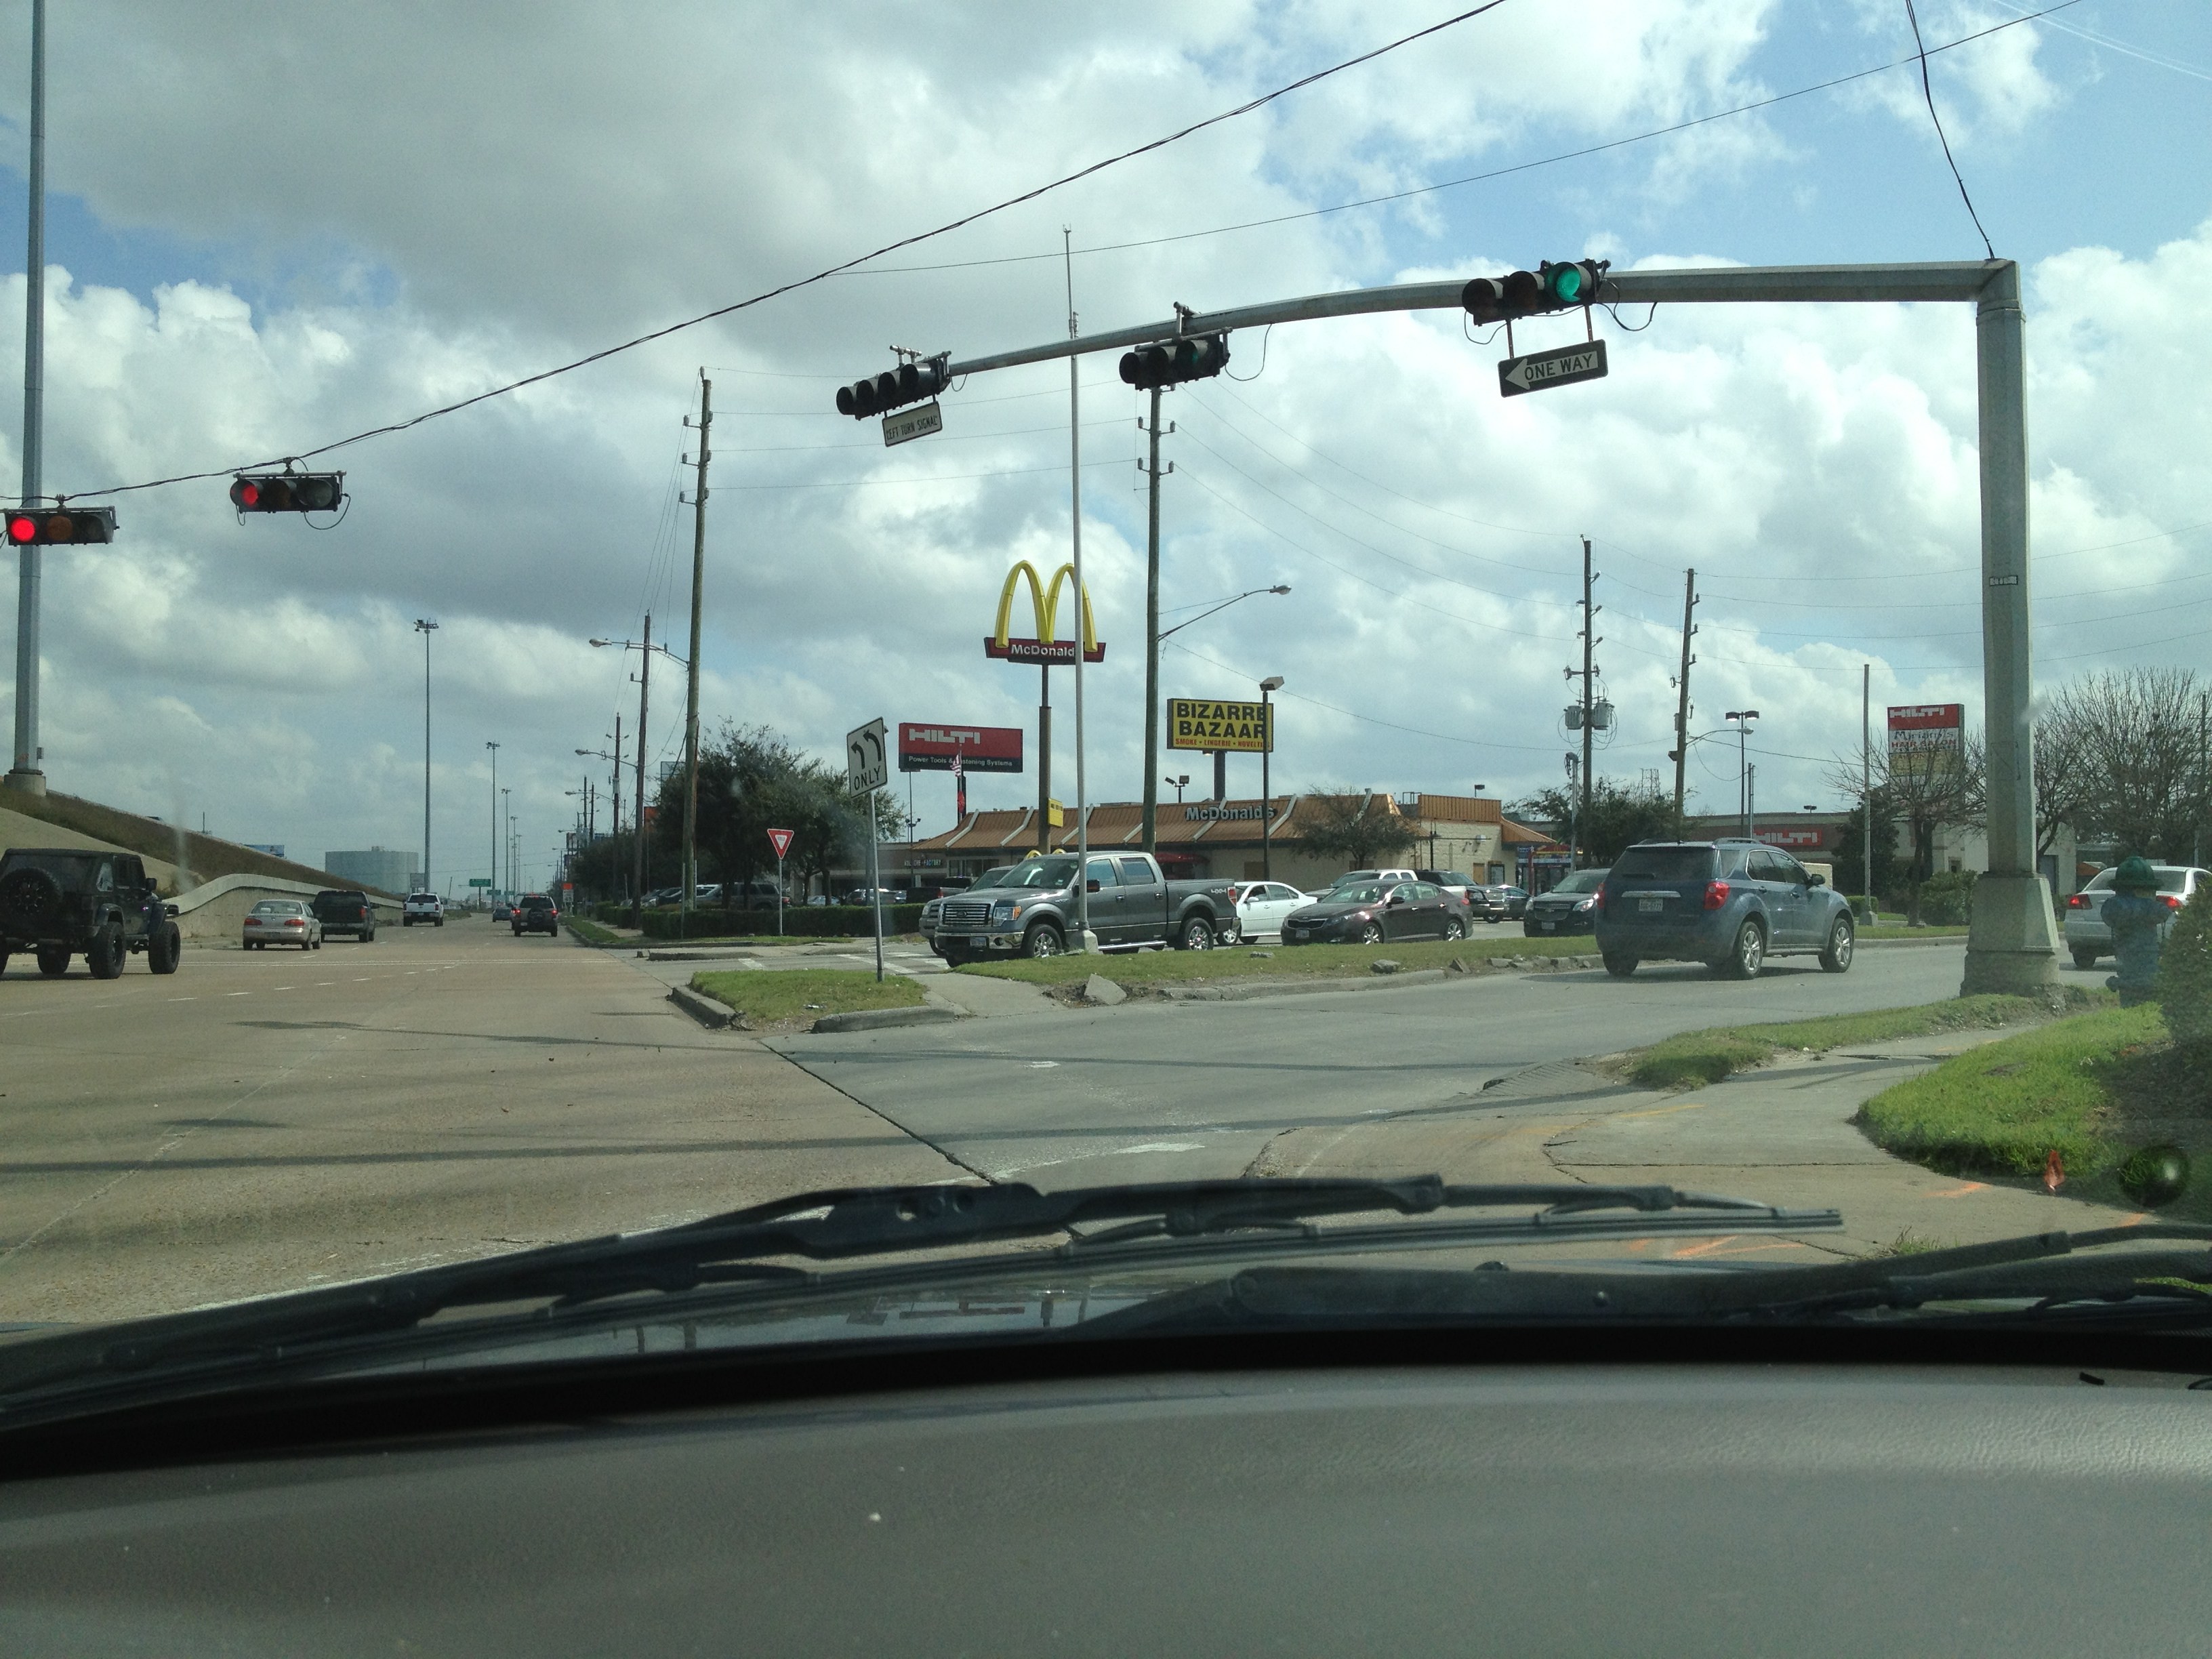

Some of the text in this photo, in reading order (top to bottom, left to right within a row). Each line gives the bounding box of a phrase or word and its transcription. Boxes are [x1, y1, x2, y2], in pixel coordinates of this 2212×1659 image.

[1524, 353, 1593, 381] ONE WAY
[886, 415, 938, 441] LEFT TURN SIGNAL
[1010, 644, 1076, 657] McDonald
[1176, 702, 1265, 722] BIZARRE
[1889, 707, 1945, 718] HILTI
[909, 728, 981, 745] HILTI
[1179, 720, 1266, 739] BAZAAR
[1204, 739, 1231, 747] LINGERIE
[1237, 740, 1263, 748] NOVELTI
[962, 758, 985, 766] stening
[986, 759, 1013, 767] Systems
[854, 765, 881, 791] ONLY
[1185, 805, 1275, 820] McDonalds
